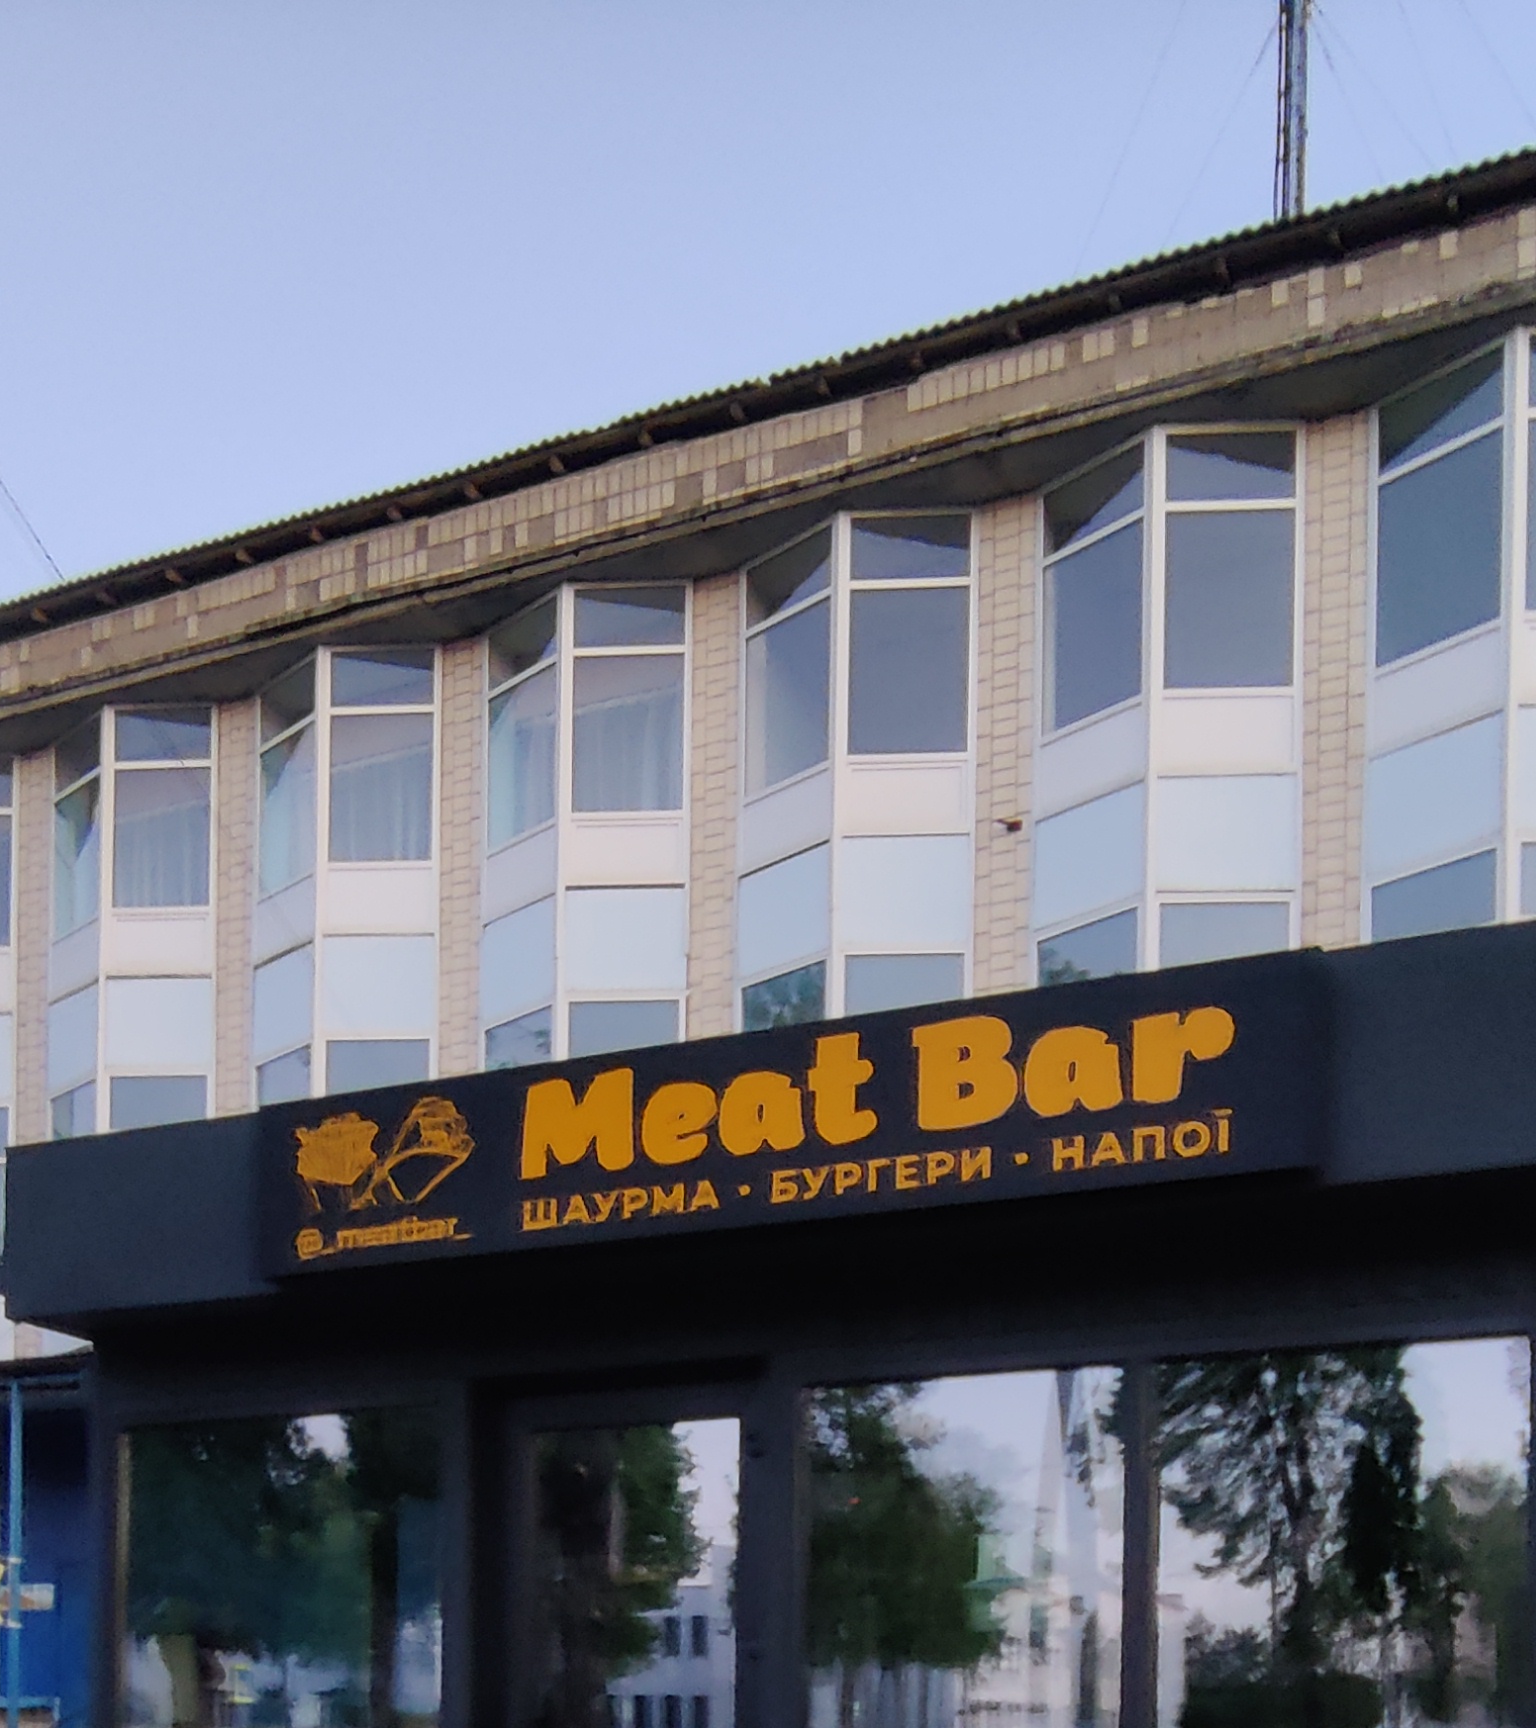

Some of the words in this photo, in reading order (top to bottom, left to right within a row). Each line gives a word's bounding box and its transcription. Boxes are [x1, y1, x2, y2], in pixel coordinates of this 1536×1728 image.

[519, 1032, 878, 1180] Meat
[912, 1006, 1235, 1131] Bar
[521, 1179, 720, 1231] ШАУРМА
[769, 1146, 992, 1204] БУРГЕРИ
[1051, 1108, 1233, 1171] НАПОЇ
